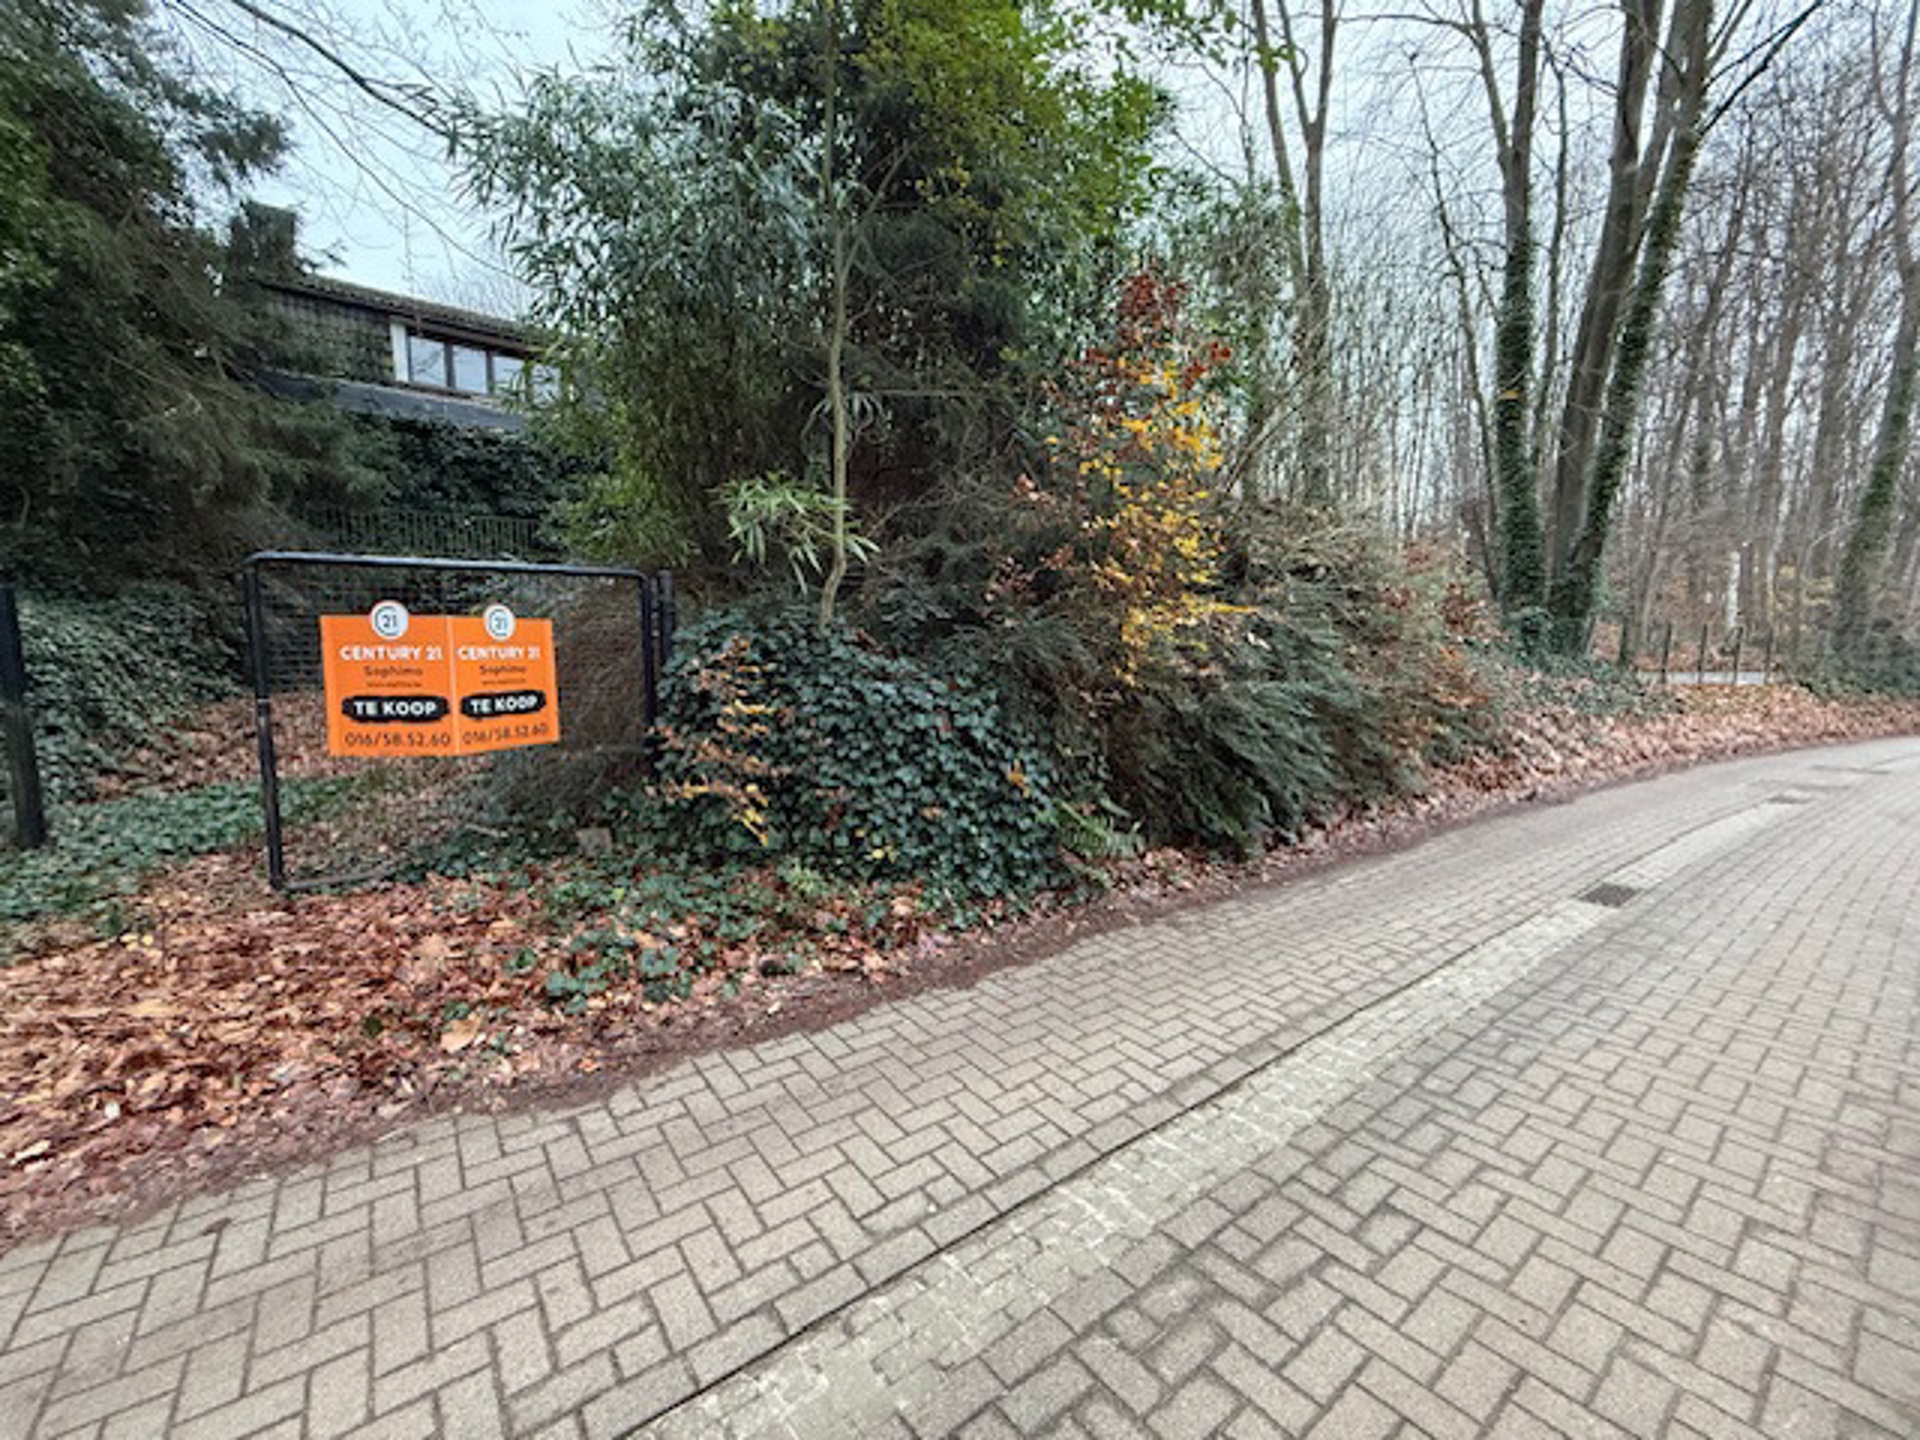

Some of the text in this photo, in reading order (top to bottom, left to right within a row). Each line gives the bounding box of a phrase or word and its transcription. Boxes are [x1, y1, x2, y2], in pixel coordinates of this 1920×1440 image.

[339, 645, 444, 661] CENTURY 21
[457, 646, 541, 661] CENTURY 21
[353, 701, 437, 716] TE KOOP
[470, 695, 538, 714] TE KOOP
[344, 731, 451, 747] 016/58.52.60
